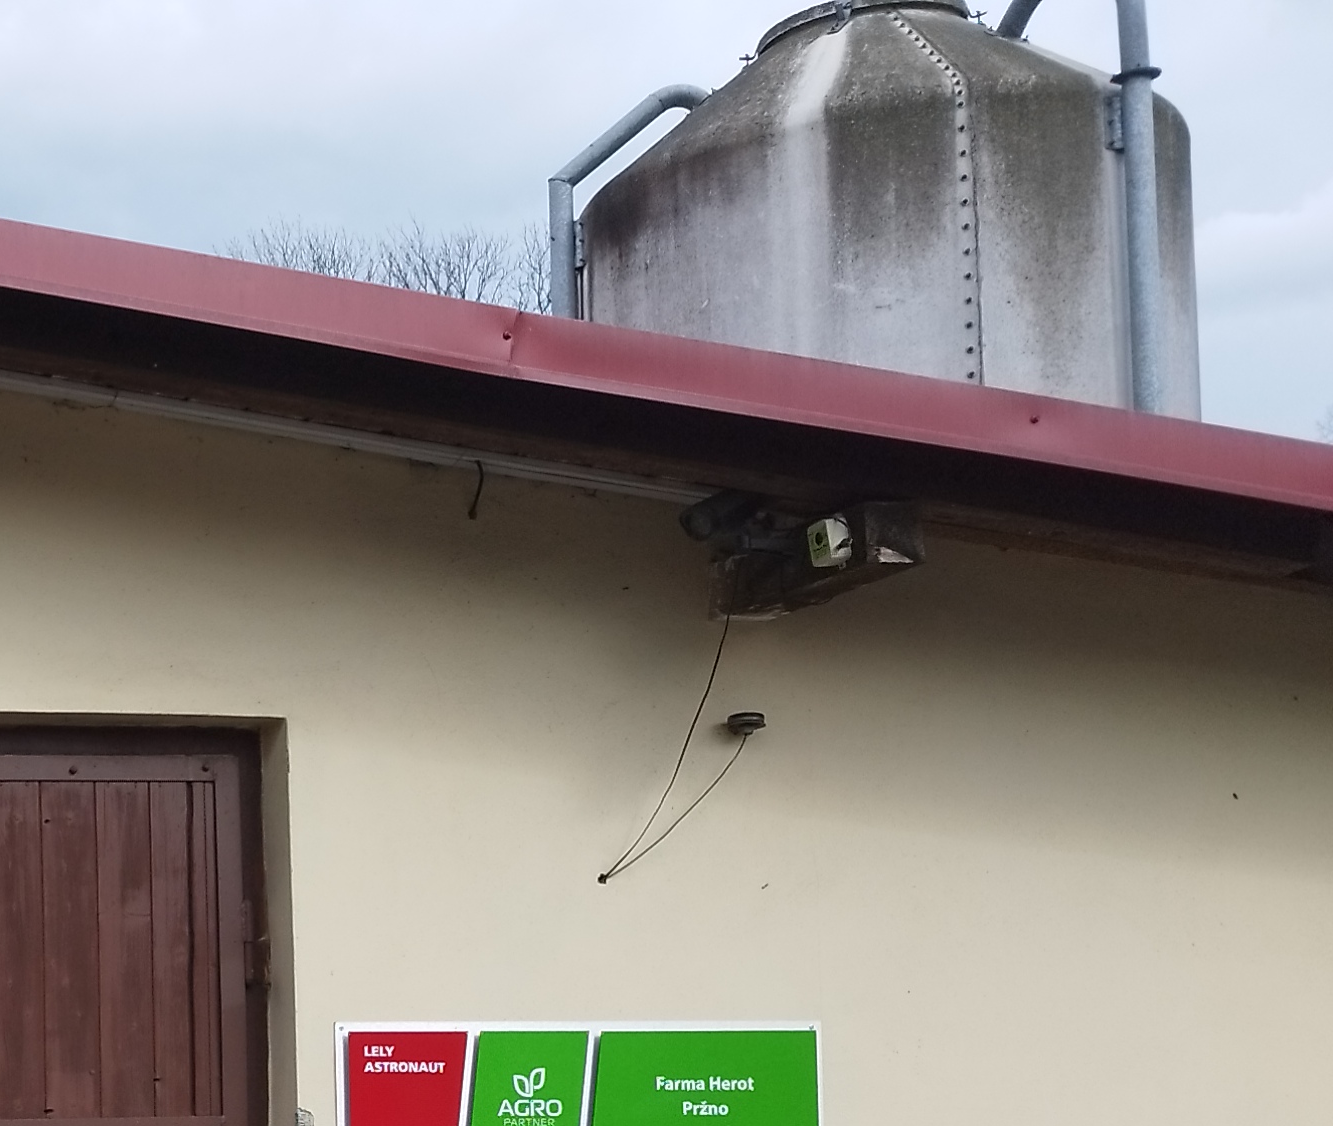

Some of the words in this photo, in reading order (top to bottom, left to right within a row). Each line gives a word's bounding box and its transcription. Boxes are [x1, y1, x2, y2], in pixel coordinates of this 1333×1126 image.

[363, 1045, 395, 1058] LELY
[363, 1061, 446, 1075] ASTRONAUT
[655, 1076, 705, 1092] Farma
[708, 1076, 755, 1092] Herot
[497, 1098, 563, 1118] AGRO
[681, 1100, 730, 1118] Pržno
